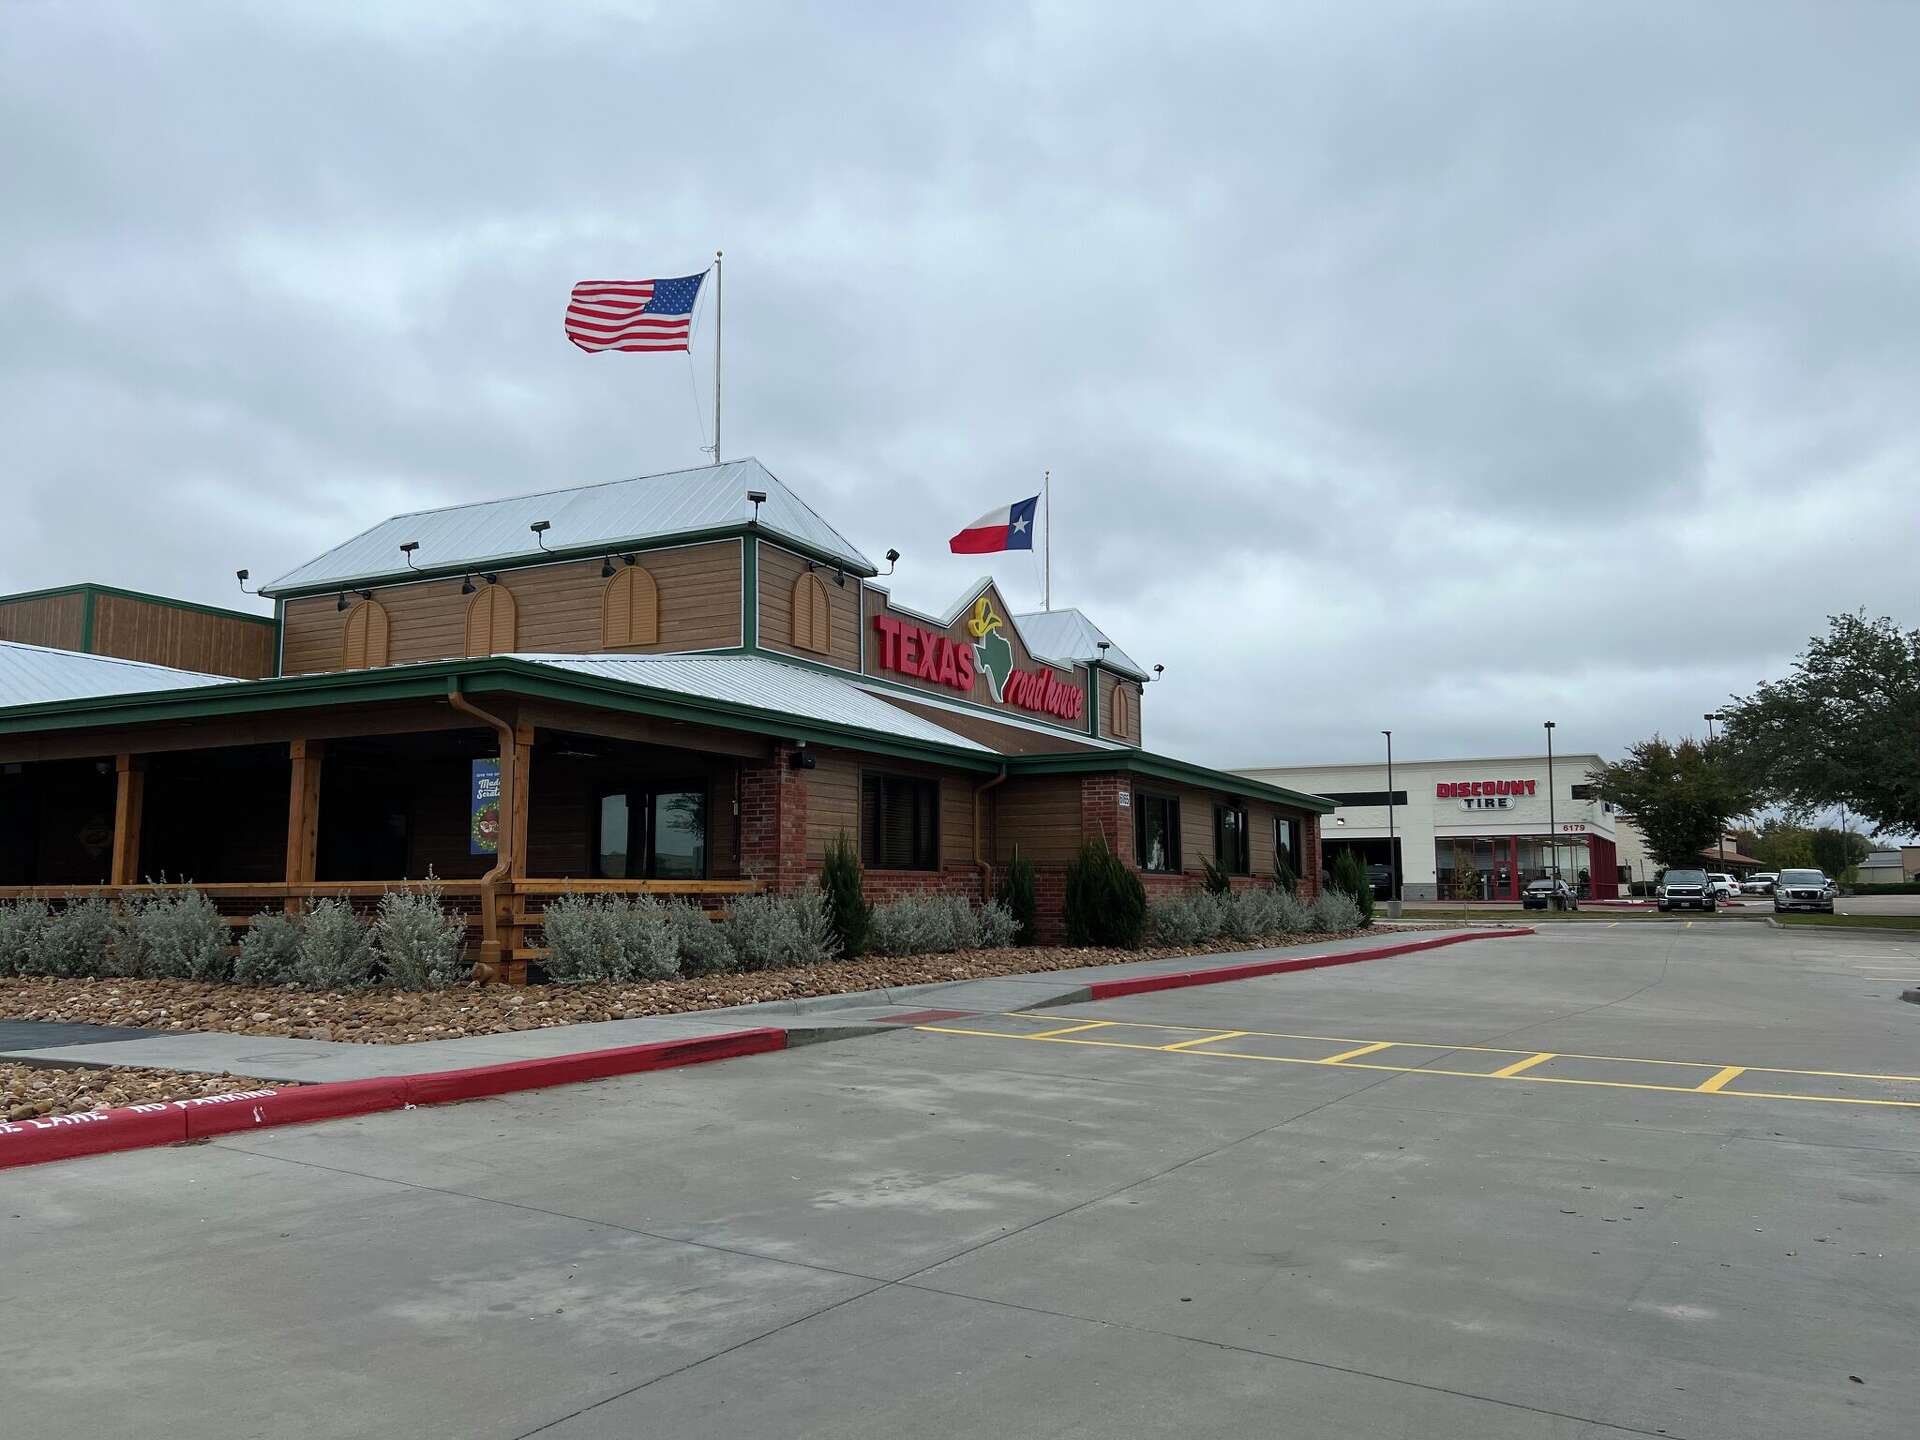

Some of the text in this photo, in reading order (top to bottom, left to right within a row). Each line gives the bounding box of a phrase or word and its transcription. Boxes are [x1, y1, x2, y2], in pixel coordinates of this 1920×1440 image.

[874, 616, 974, 690] TEXAS
[1436, 780, 1536, 797] DISCOUNT
[1464, 798, 1508, 808] TIRE
[1563, 824, 1586, 832] 6179
[30, 1111, 108, 1128] LANE
[128, 1102, 168, 1114] NO
